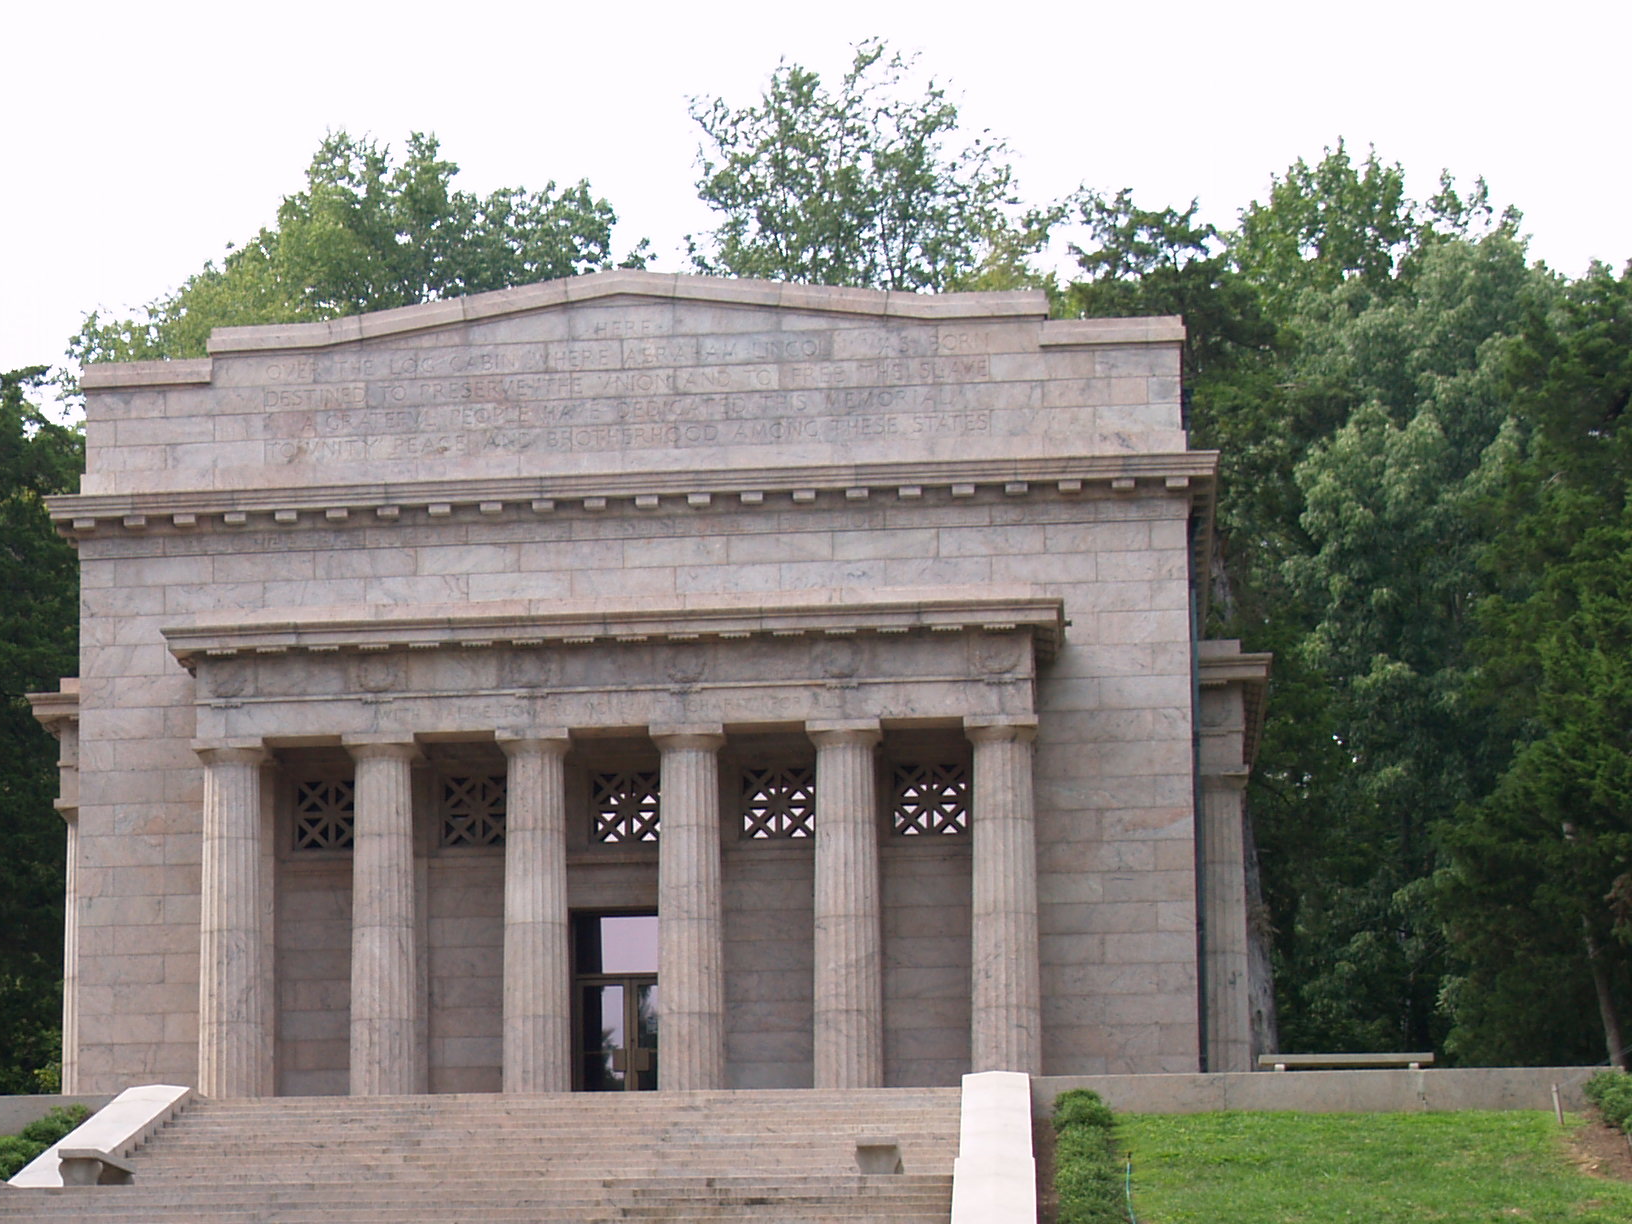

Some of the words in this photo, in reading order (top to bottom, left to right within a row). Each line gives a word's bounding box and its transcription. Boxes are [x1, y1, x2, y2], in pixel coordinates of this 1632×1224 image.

[594, 320, 651, 336] HERE
[266, 360, 322, 381] OVER
[338, 358, 373, 378] THE
[389, 355, 435, 376] LOG
[448, 352, 516, 373] CABIN
[528, 349, 609, 370] WHERE
[931, 332, 989, 351] BORN
[266, 386, 367, 409] DESTINED
[379, 384, 408, 401] TO
[420, 378, 528, 401] PRESERVE
[538, 375, 583, 395] THE
[684, 369, 731, 389] AND
[744, 367, 772, 387] TO
[792, 365, 846, 386] FREE
[859, 362, 902, 382] THE
[919, 359, 988, 380] SLAVE
[301, 414, 314, 431] A
[451, 405, 531, 426] PEOPLE
[544, 401, 601, 422] HAVE
[619, 396, 746, 420] DEDICATED
[760, 393, 808, 413] THIS
[825, 387, 954, 410] MEMORIAL
[267, 440, 295, 459] TO
[394, 434, 467, 455] PEACE
[546, 425, 718, 449] BROTHERHOOD
[734, 419, 819, 440] AMONG
[832, 415, 898, 437] THESE
[912, 413, 988, 434] STATES
